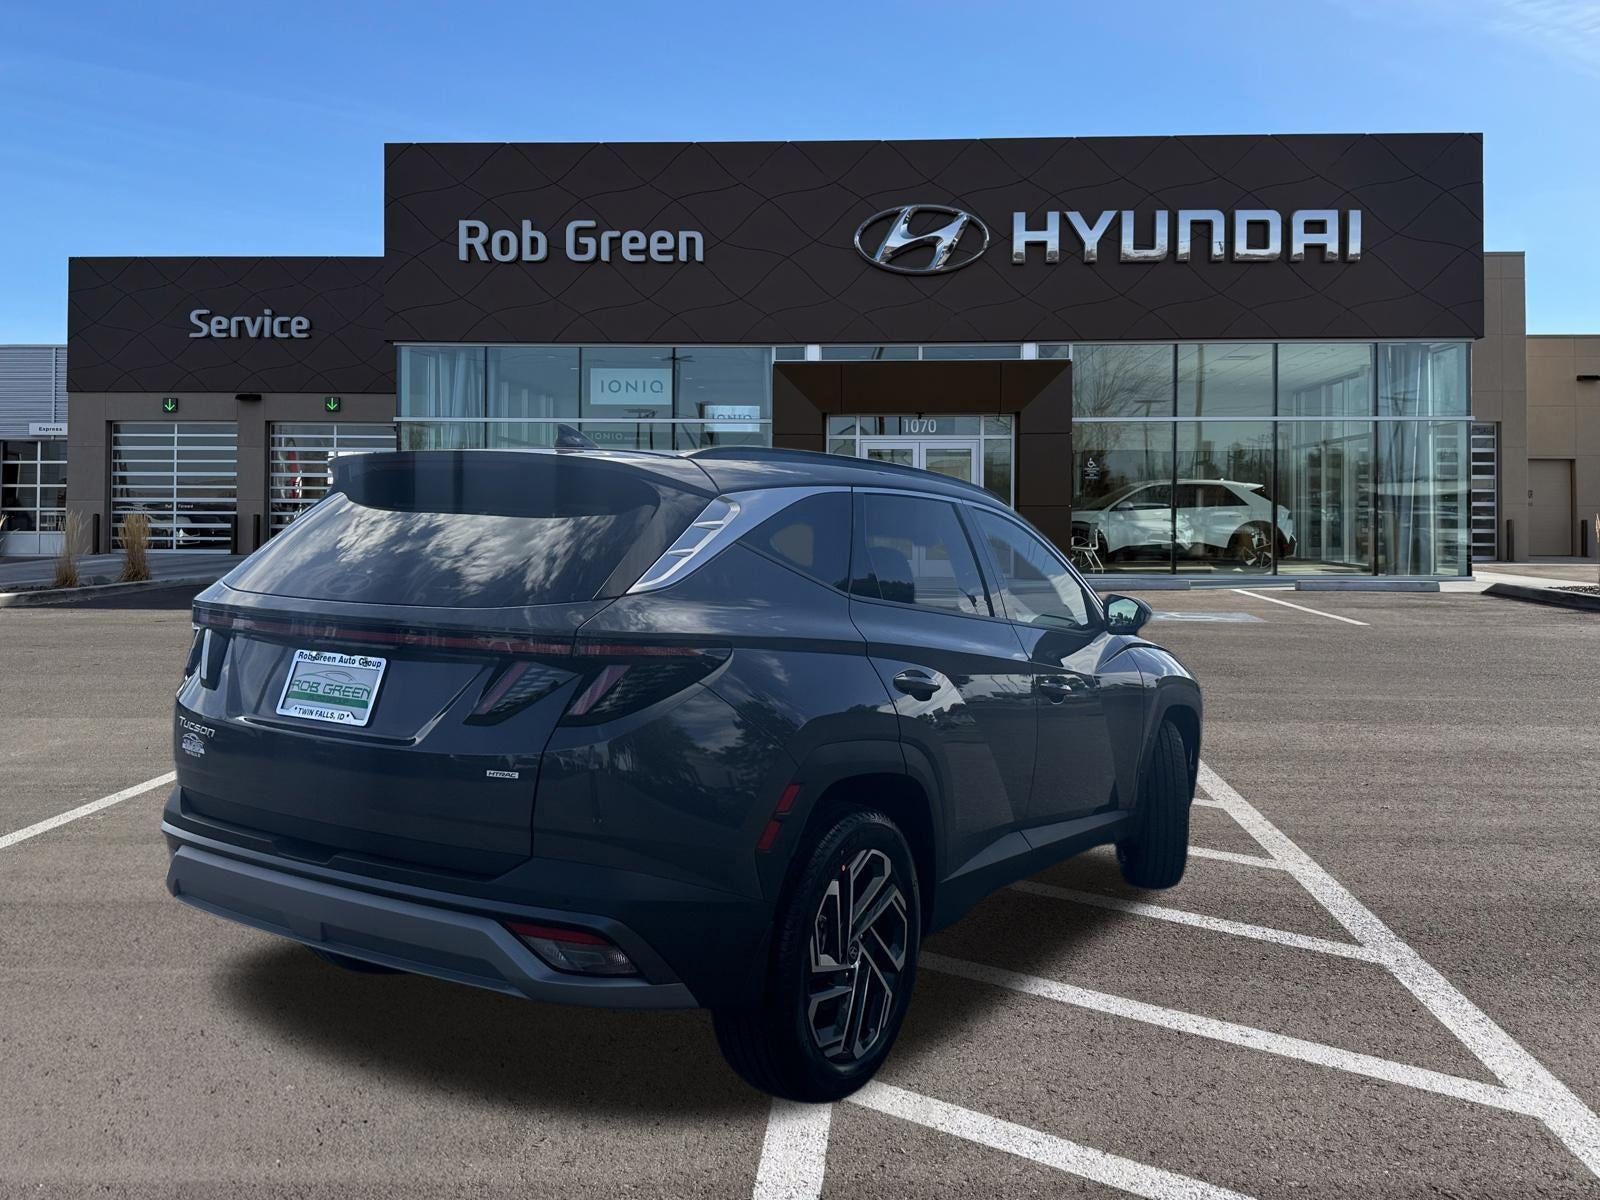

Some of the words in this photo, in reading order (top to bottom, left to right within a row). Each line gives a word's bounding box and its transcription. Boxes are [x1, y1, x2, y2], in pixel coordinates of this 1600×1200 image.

[458, 219, 549, 263] Rob
[565, 219, 705, 263] Green
[1011, 209, 1363, 264] HYUNDAI
[188, 308, 312, 339] Service
[600, 379, 665, 394] IONIQ
[904, 418, 937, 433] 1070
[298, 651, 314, 661] Rob
[315, 652, 337, 663] Green
[338, 655, 356, 665] Auto
[291, 679, 320, 693] ROB
[323, 683, 372, 700] GREEN
[298, 707, 315, 716] TWIN
[337, 712, 346, 721] ID
[488, 770, 518, 778] HTRAC
